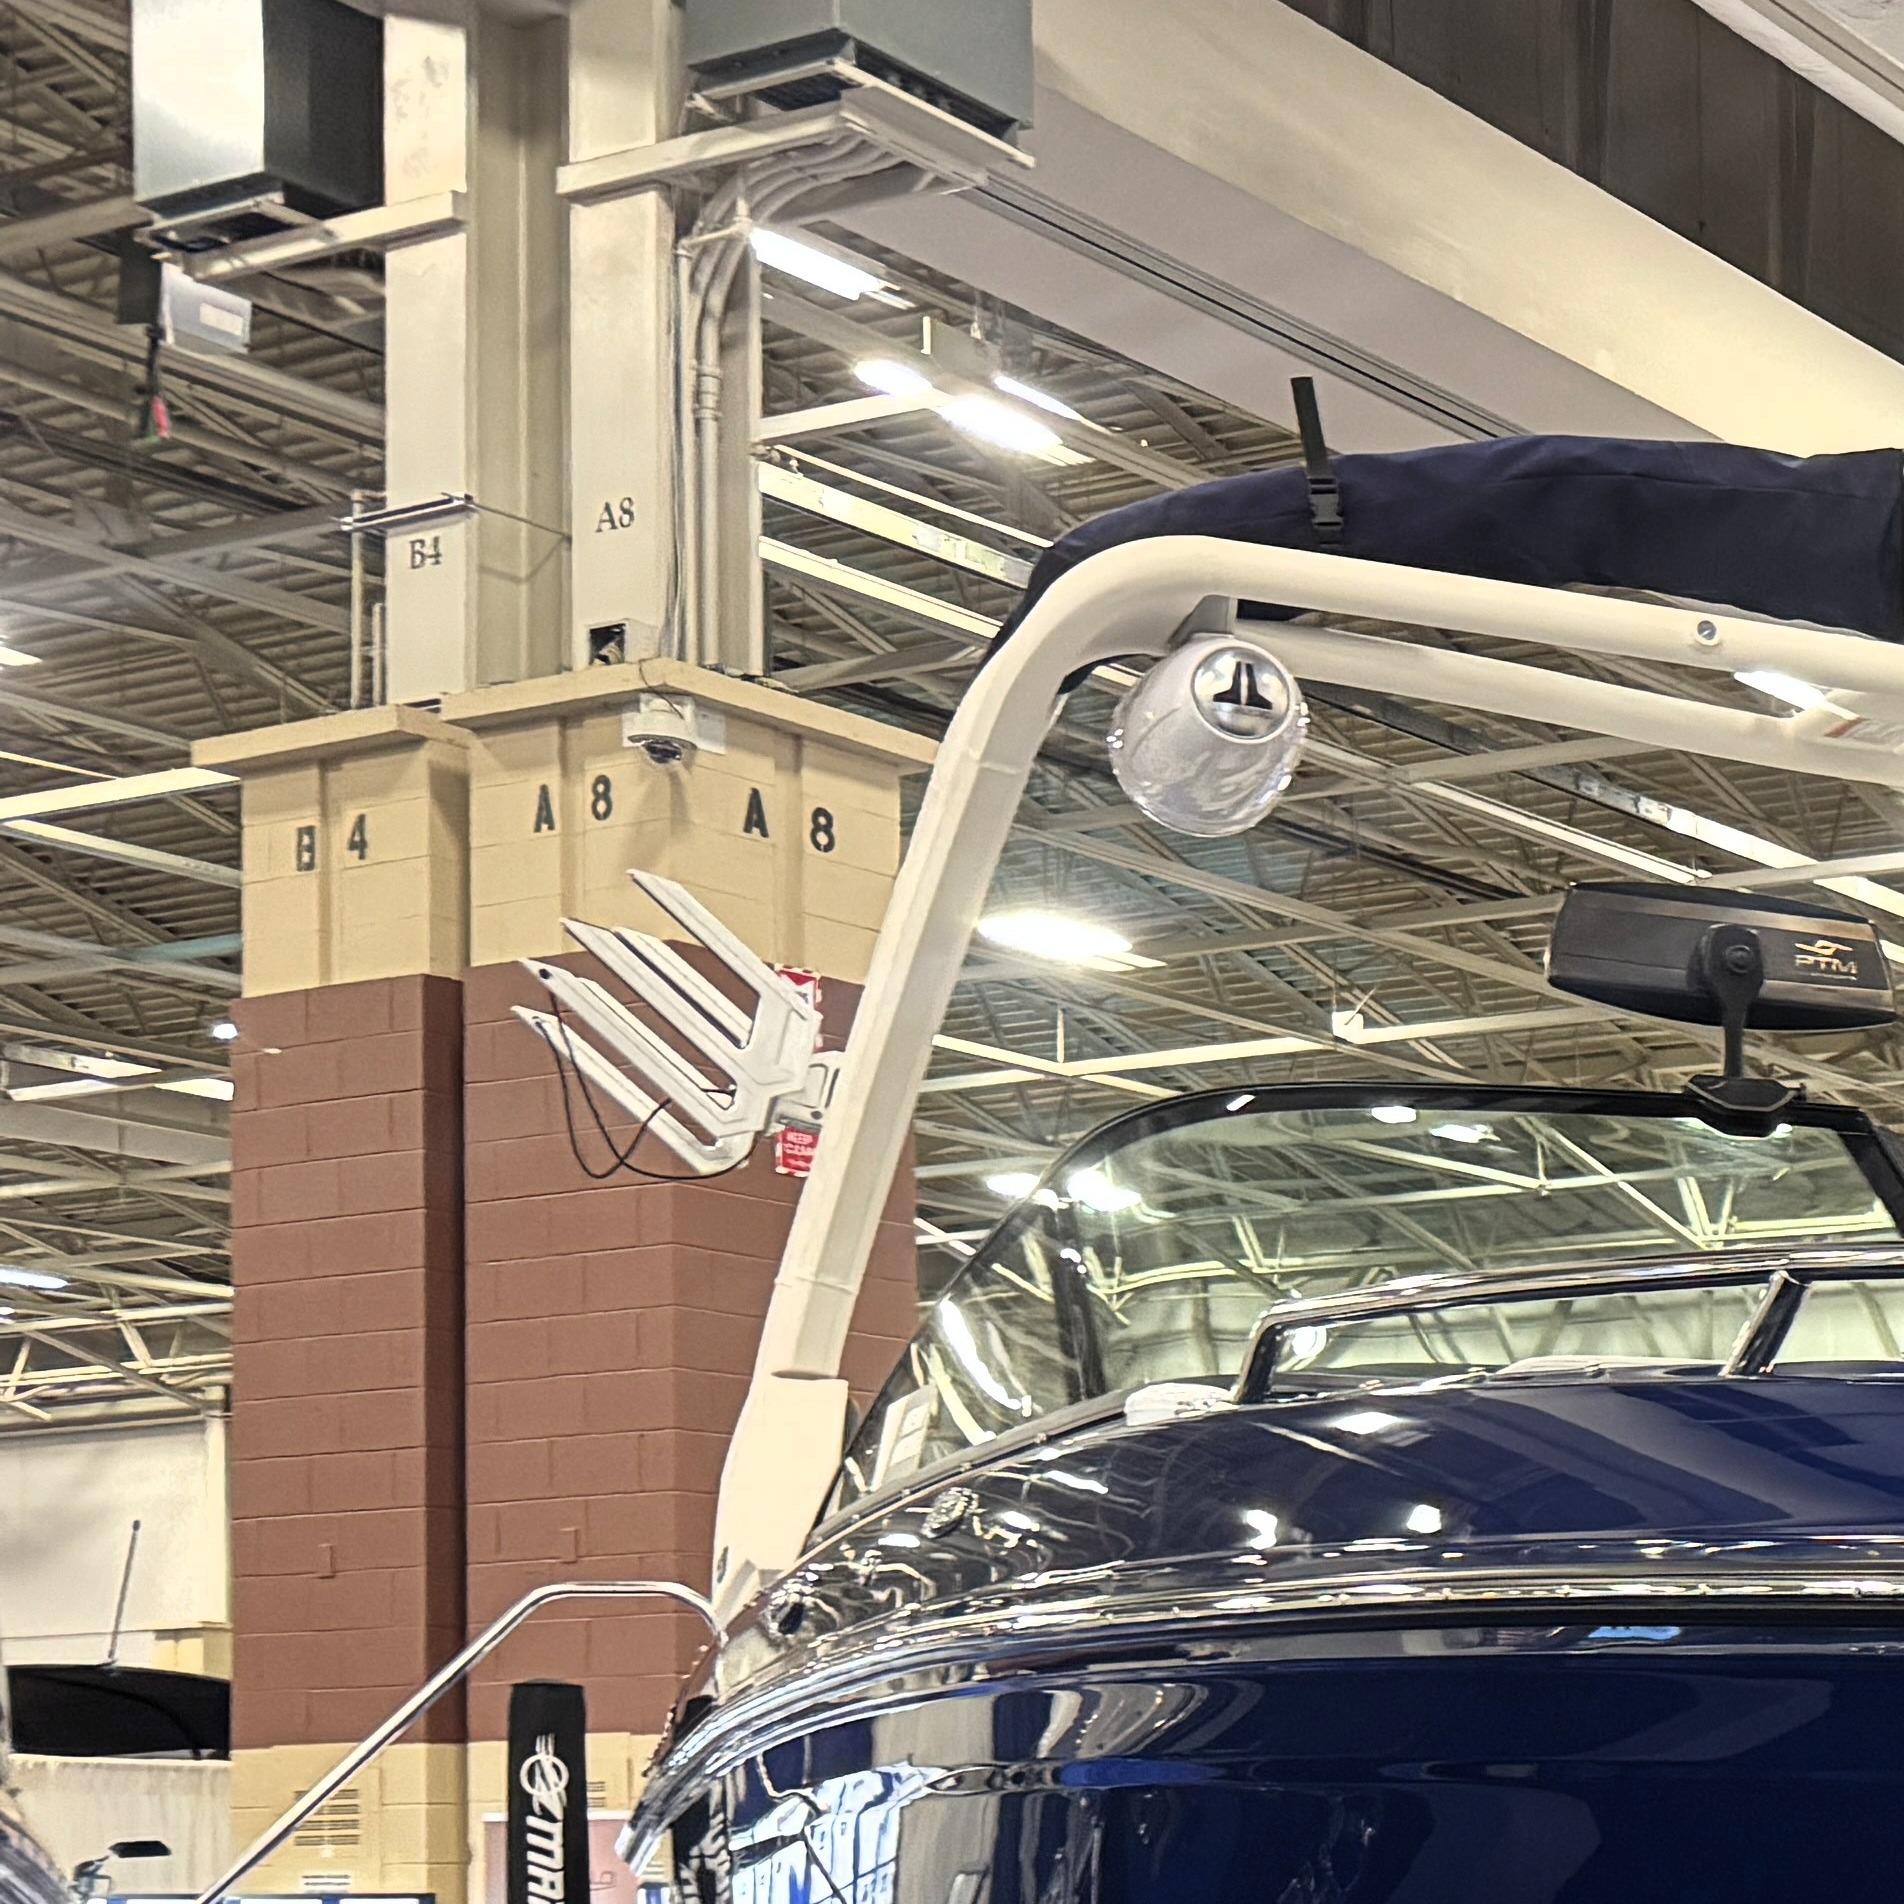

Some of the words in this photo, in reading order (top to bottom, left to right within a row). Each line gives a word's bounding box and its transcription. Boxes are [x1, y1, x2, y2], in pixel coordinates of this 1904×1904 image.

[595, 497, 635, 533] A8
[408, 535, 443, 570] B4
[533, 783, 557, 834] A
[590, 773, 614, 822] 8
[742, 786, 770, 839] A
[809, 806, 836, 854] 8
[346, 812, 369, 861] 4
